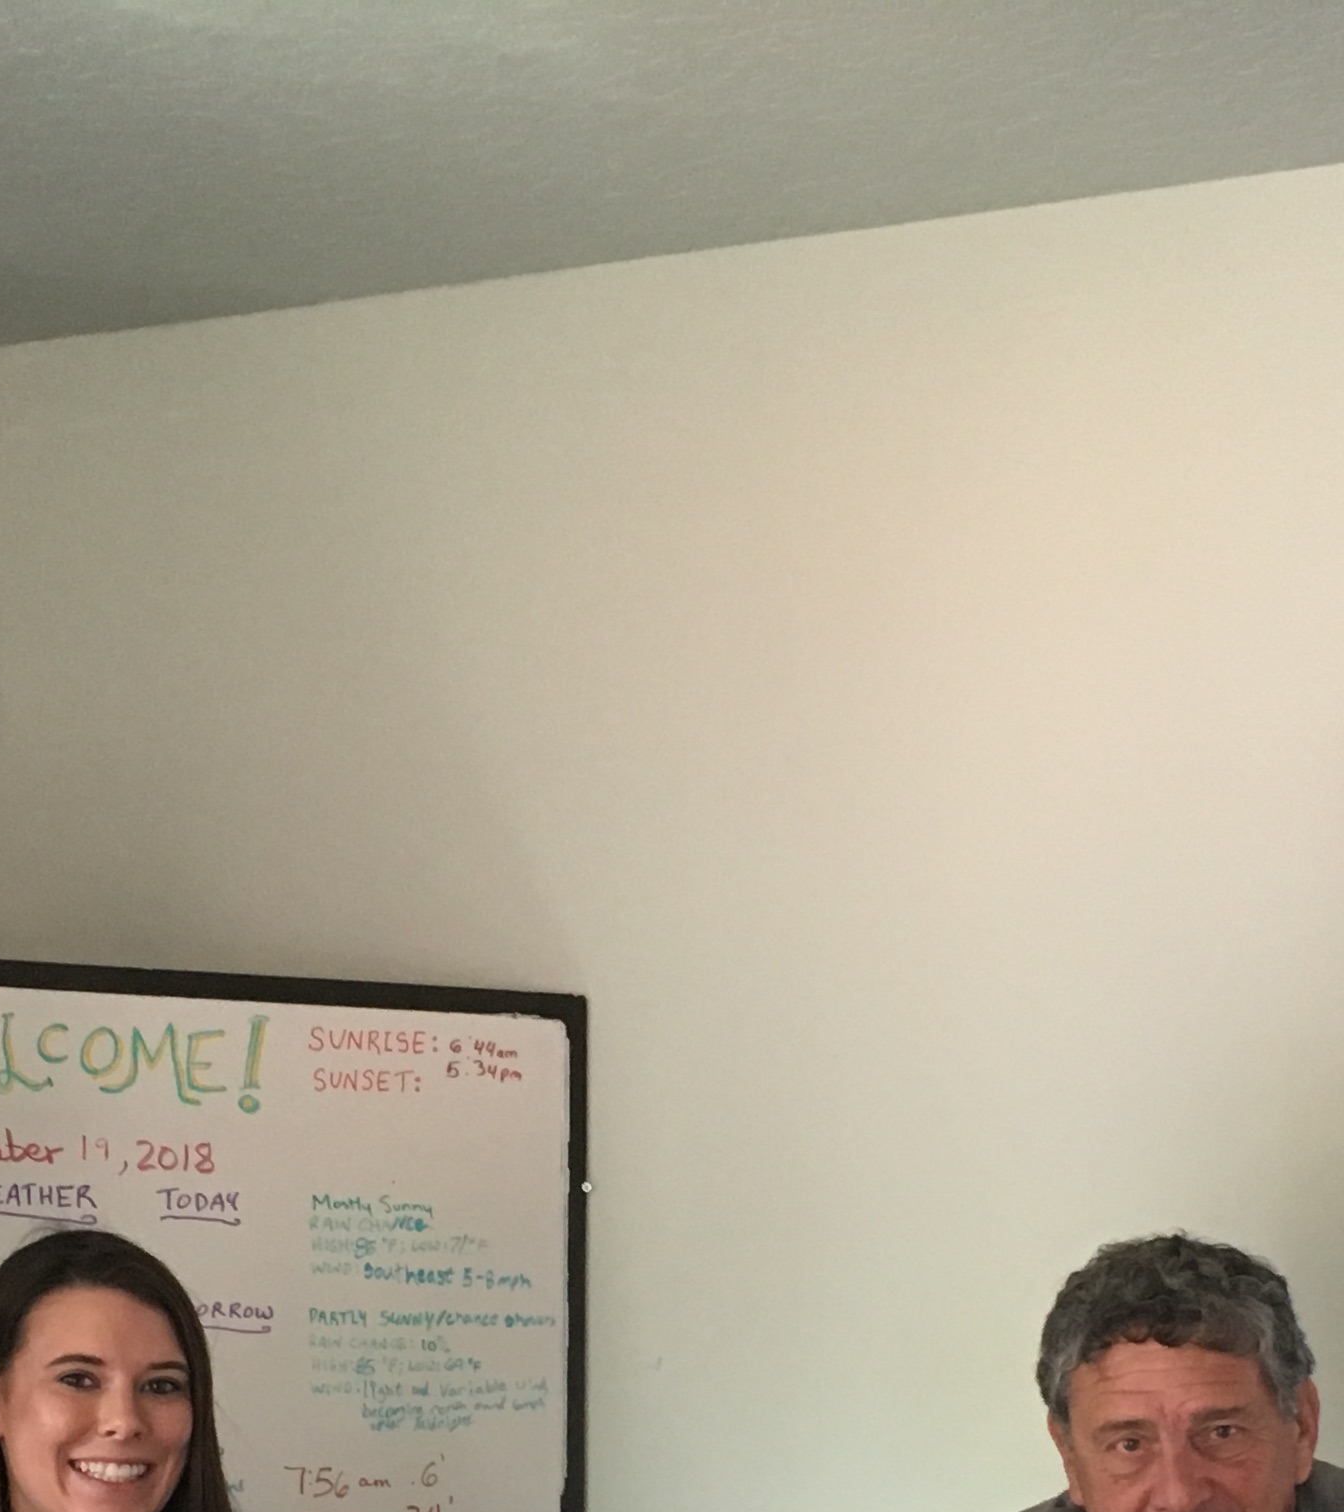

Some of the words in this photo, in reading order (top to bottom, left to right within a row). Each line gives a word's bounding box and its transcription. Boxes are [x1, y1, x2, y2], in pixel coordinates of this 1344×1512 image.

[307, 1025, 438, 1056] SUNRISE:
[312, 1067, 423, 1094] SUNSET:
[136, 1140, 216, 1175] 2018
[155, 1187, 241, 1213] TODAY
[312, 1193, 373, 1217] Mostly
[378, 1194, 435, 1219] Sunny
[196, 1301, 274, 1322] ORROW
[283, 1465, 349, 1499] 7:56
[357, 1475, 392, 1489] am
